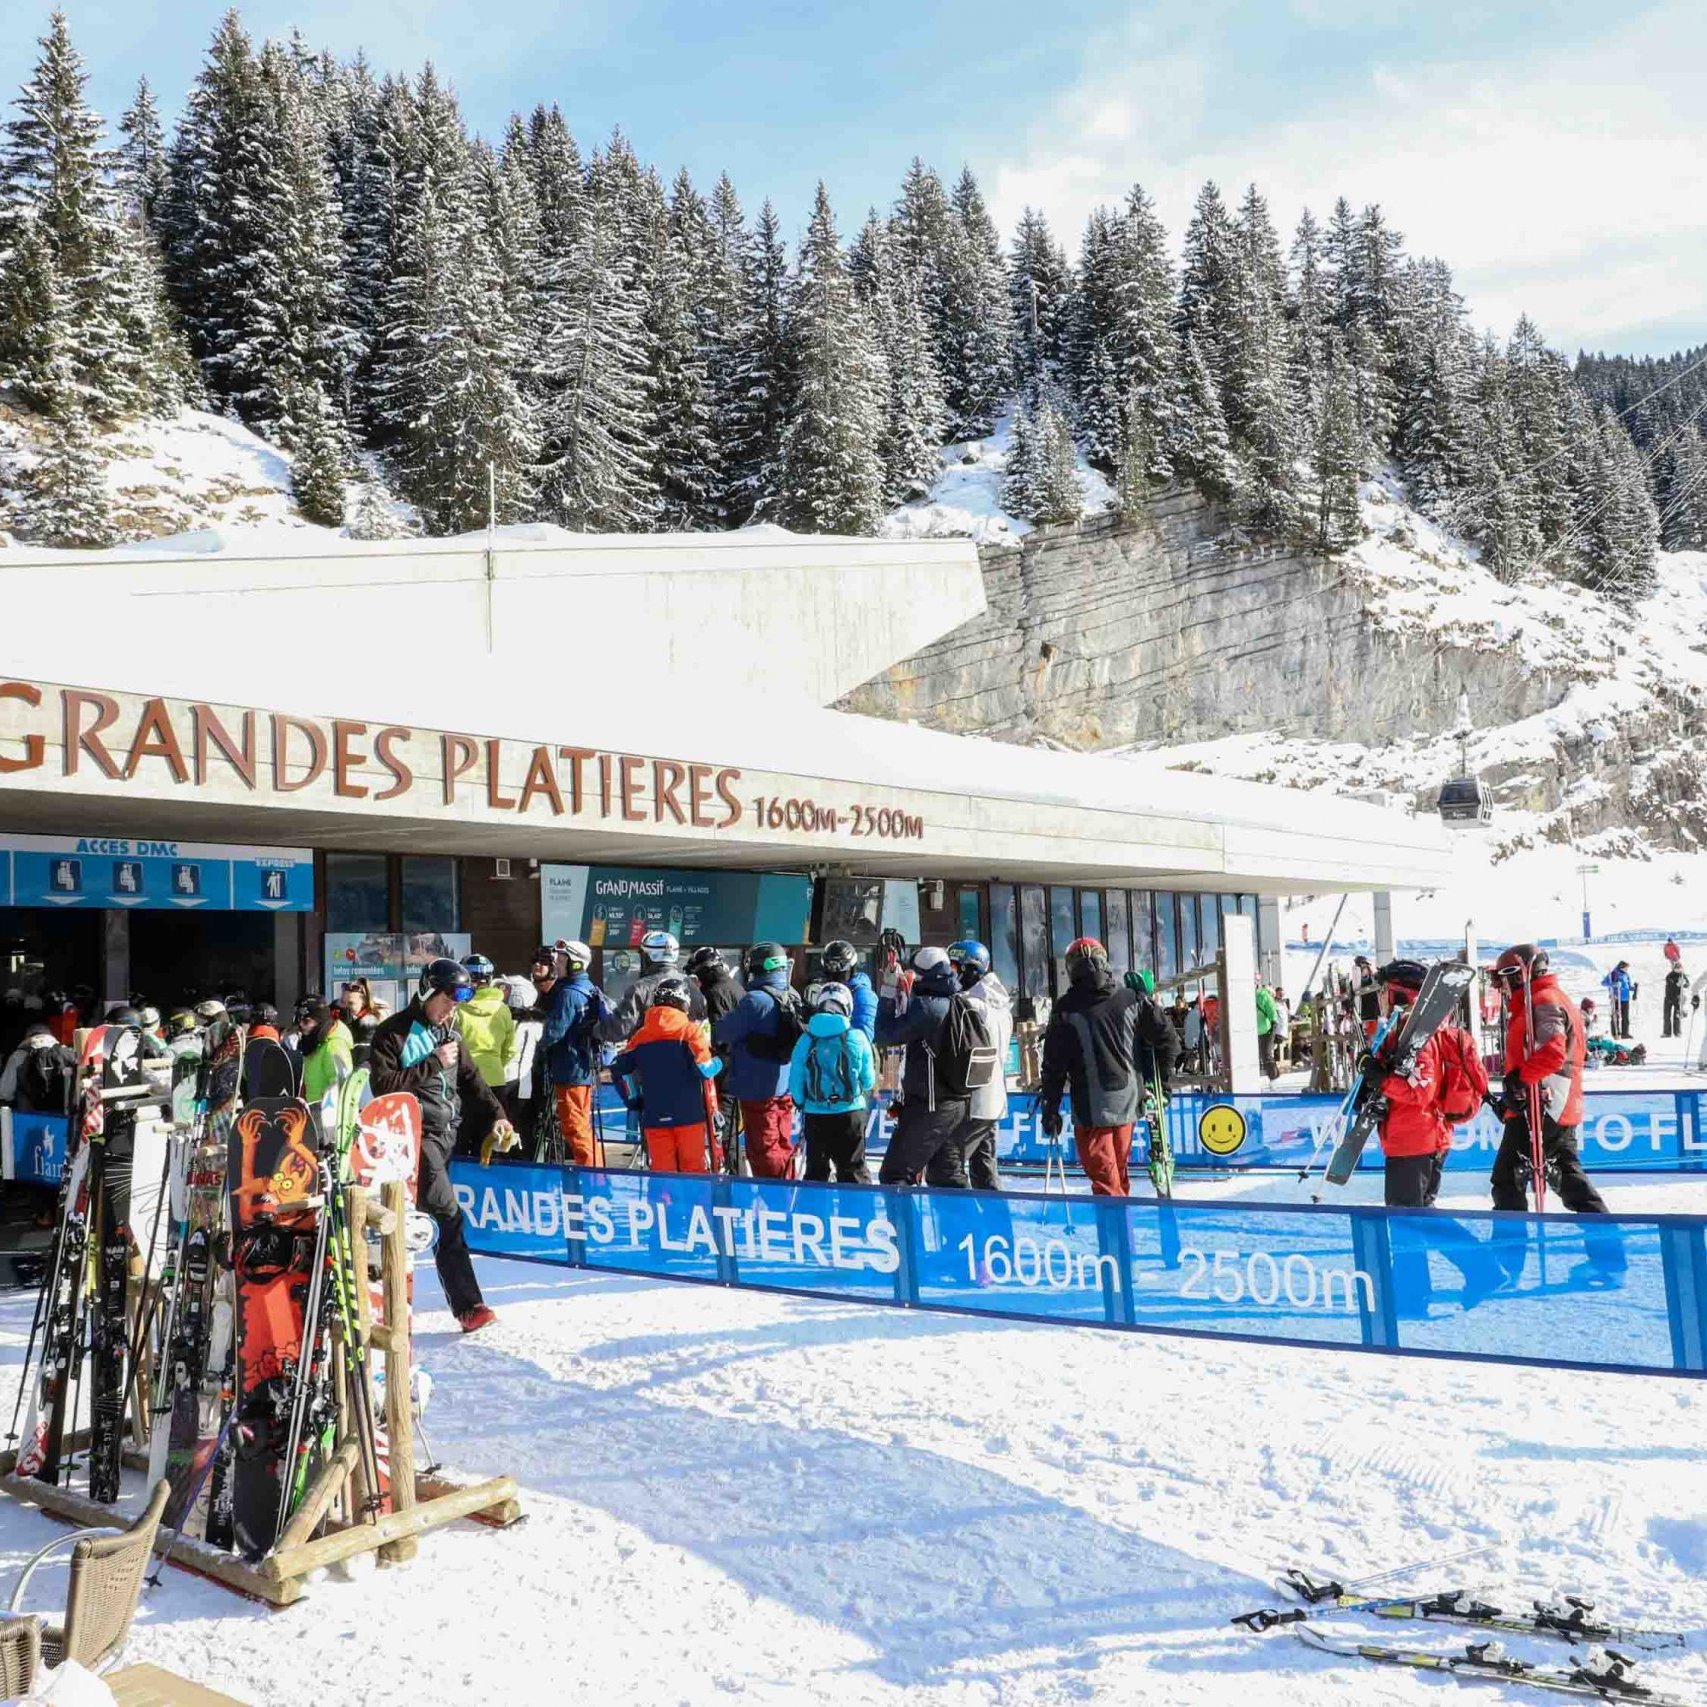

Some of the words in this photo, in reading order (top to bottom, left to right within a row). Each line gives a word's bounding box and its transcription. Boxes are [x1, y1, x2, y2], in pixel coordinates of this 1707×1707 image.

[0, 682, 413, 800] GRANDES
[441, 734, 742, 829] PLATIERES
[76, 838, 128, 855] ACCES
[136, 841, 178, 857] DMC
[455, 1183, 616, 1243] RANDES
[630, 1204, 901, 1273] PLATIERES
[958, 1233, 1122, 1293] 1600m
[1177, 1247, 1376, 1313] 2500m
